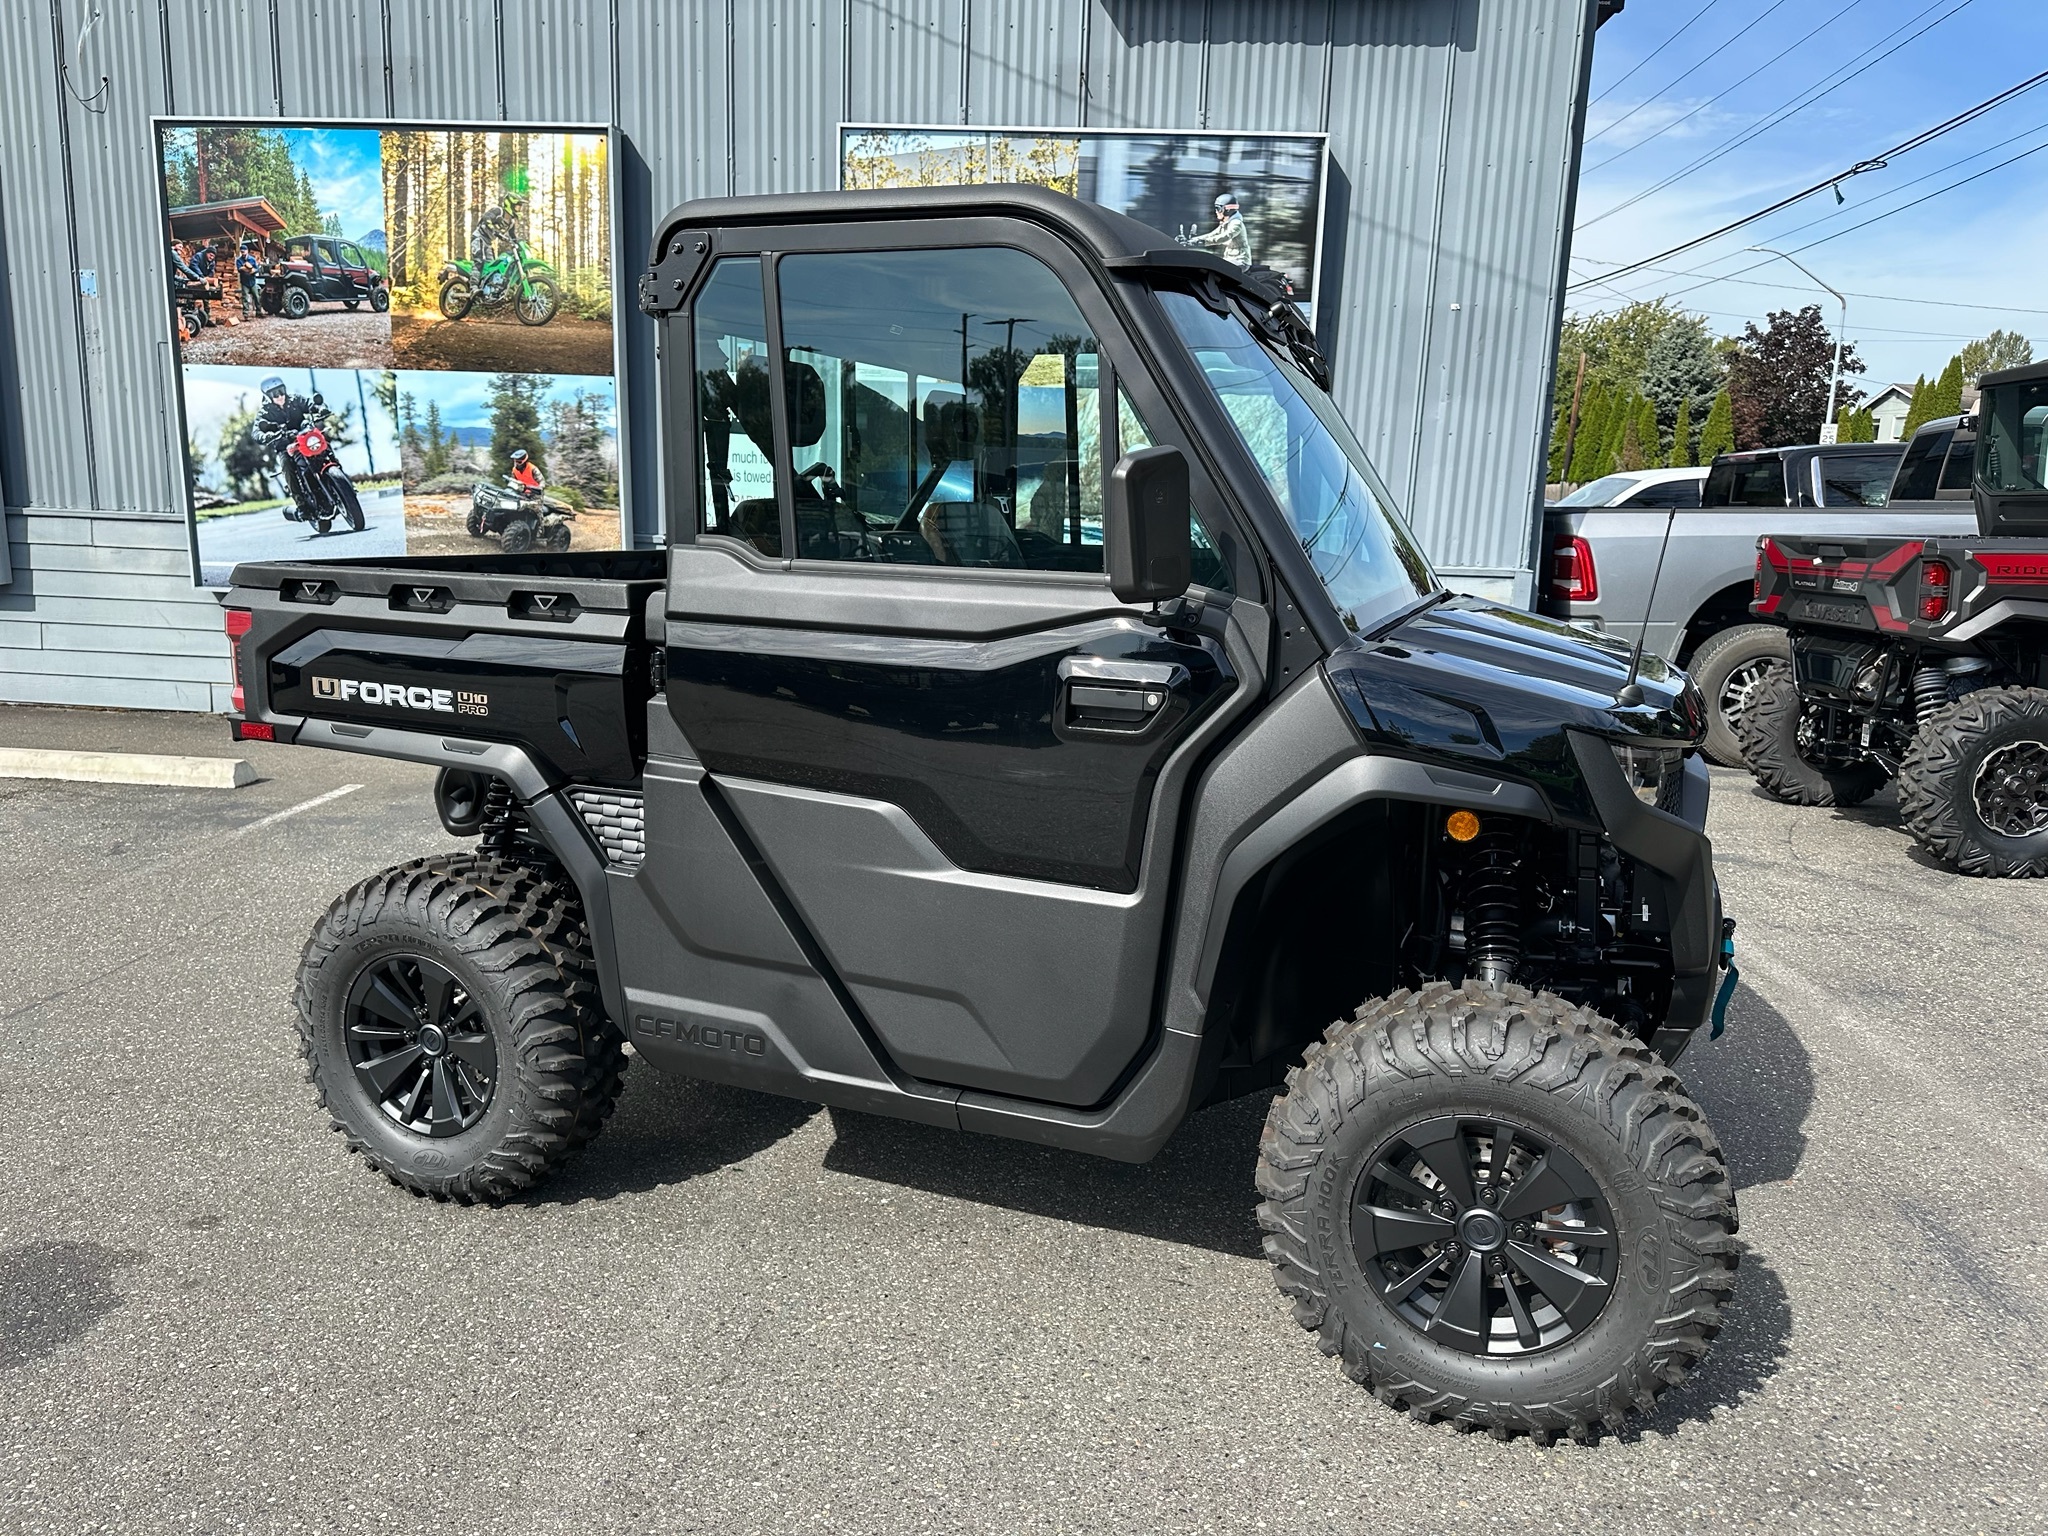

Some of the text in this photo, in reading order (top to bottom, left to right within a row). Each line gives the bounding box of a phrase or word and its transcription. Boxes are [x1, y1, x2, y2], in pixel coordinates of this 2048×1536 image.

[1821, 434, 1835, 443] 25
[732, 450, 758, 463] much
[734, 469, 741, 482] is
[457, 691, 488, 704] U10
[458, 704, 488, 716] PRO
[634, 1014, 766, 1057] CFMOTO
[413, 1153, 447, 1169] ITP
[1317, 1151, 1348, 1295] TERRA HOOK
[1640, 1232, 1662, 1289] ITP
